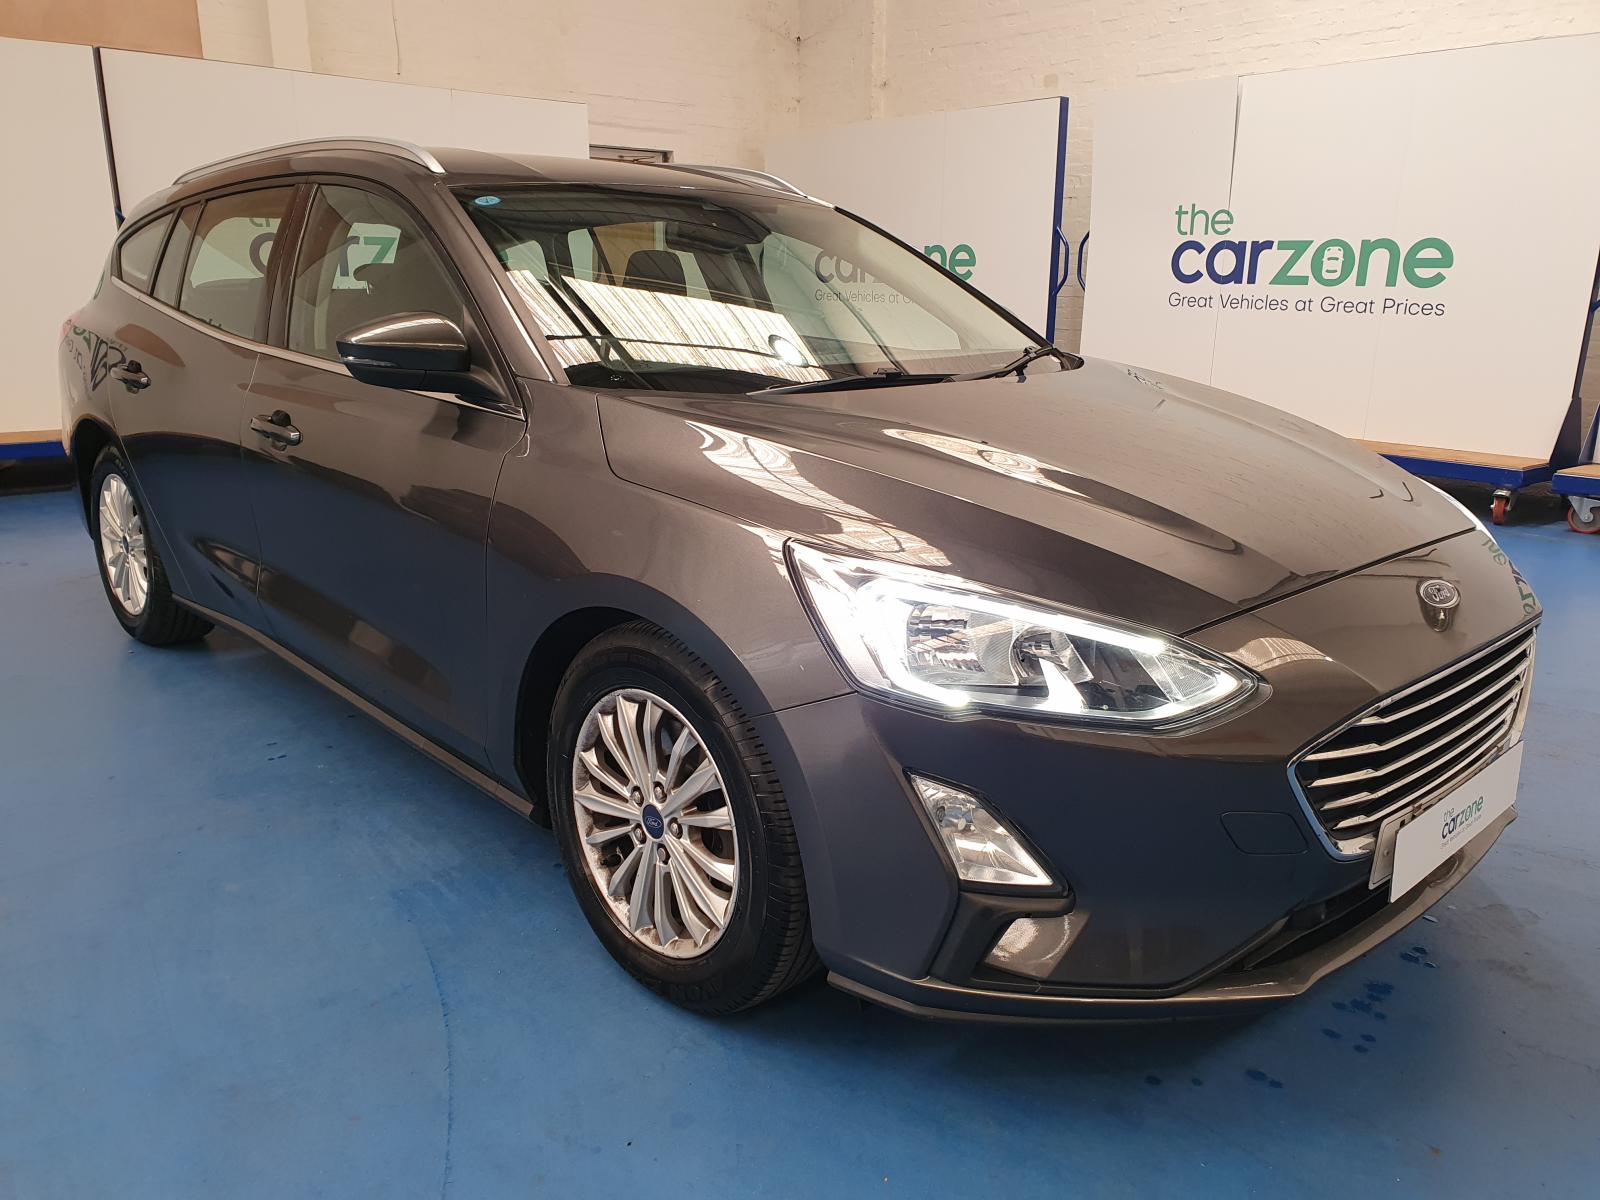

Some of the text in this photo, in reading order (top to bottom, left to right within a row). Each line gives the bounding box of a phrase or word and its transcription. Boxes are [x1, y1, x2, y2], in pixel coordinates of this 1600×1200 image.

[1175, 203, 1234, 236] the
[1171, 237, 1454, 289] carzone
[815, 288, 841, 302] Great
[845, 290, 886, 303] Vehicles
[888, 293, 899, 304] at
[1168, 291, 1446, 317] Great Vehicles at Great Prices
[1441, 796, 1484, 839] carzone
